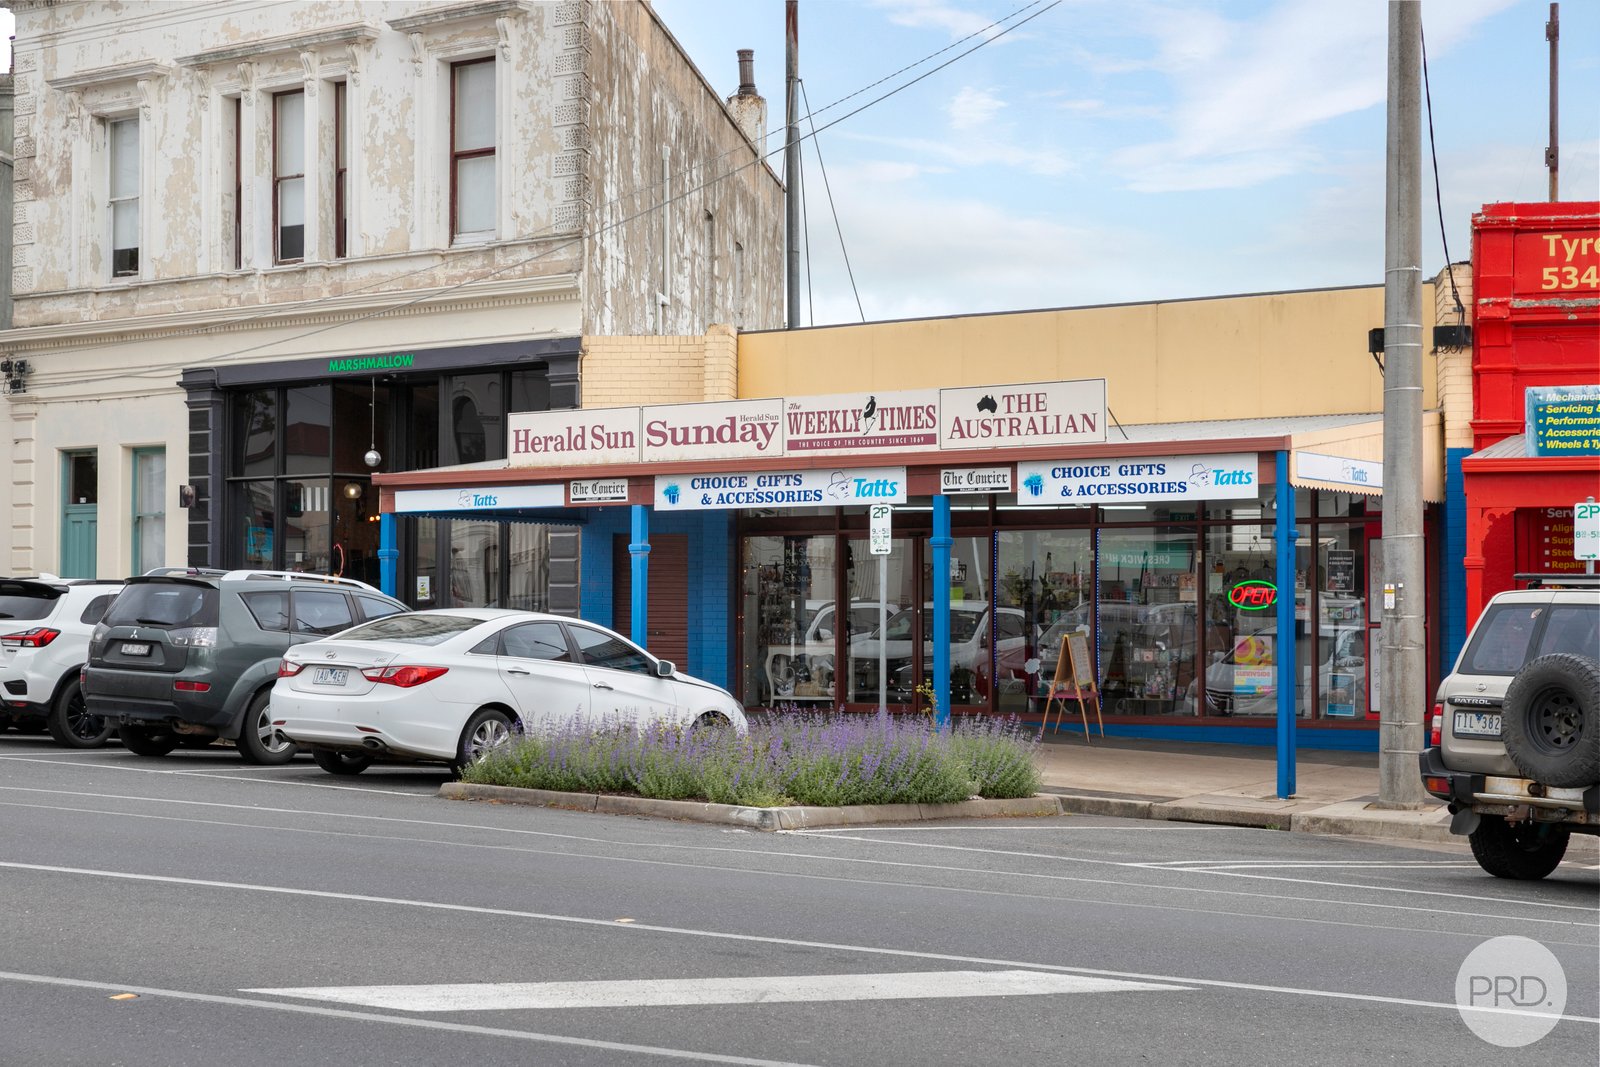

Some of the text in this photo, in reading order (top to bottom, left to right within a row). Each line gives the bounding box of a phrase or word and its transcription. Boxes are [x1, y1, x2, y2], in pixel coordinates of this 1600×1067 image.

[1542, 265, 1600, 290] 534
[328, 354, 414, 371] MARSHMALLOW
[789, 402, 801, 410] The
[1002, 392, 1047, 414] THE
[1546, 404, 1594, 414] Servicing
[740, 413, 779, 422] Herald Sun
[787, 405, 936, 435] WEEKLY TIMES
[646, 416, 779, 450] Sunday
[948, 412, 1097, 440] AUSTRALIAN
[513, 424, 635, 454] Herald Sun
[799, 441, 810, 449] THE
[812, 440, 831, 448] VOICE
[833, 439, 841, 447] OF
[844, 439, 855, 447] THE
[858, 437, 886, 446] COUNTRY
[889, 437, 907, 445] SINCE
[1546, 440, 1582, 449] Wheels
[1583, 440, 1590, 448] &
[943, 470, 1008, 486] The Courier
[1051, 463, 1166, 479] CHOICE GIFTS
[1212, 469, 1253, 486] Tatts
[1351, 466, 1368, 482] Tatts
[572, 481, 625, 496] The Courier
[691, 474, 803, 490] CHOICE GIFTS
[854, 478, 898, 498] Tatts
[1061, 481, 1187, 497] & ACCESSORIES
[472, 494, 498, 507] Tatts
[701, 489, 823, 505] & ACCESSORIES
[872, 506, 889, 519] 2P
[1577, 505, 1600, 519] 2P
[1231, 586, 1275, 605] OPEN
[1481, 716, 1500, 730] 382
